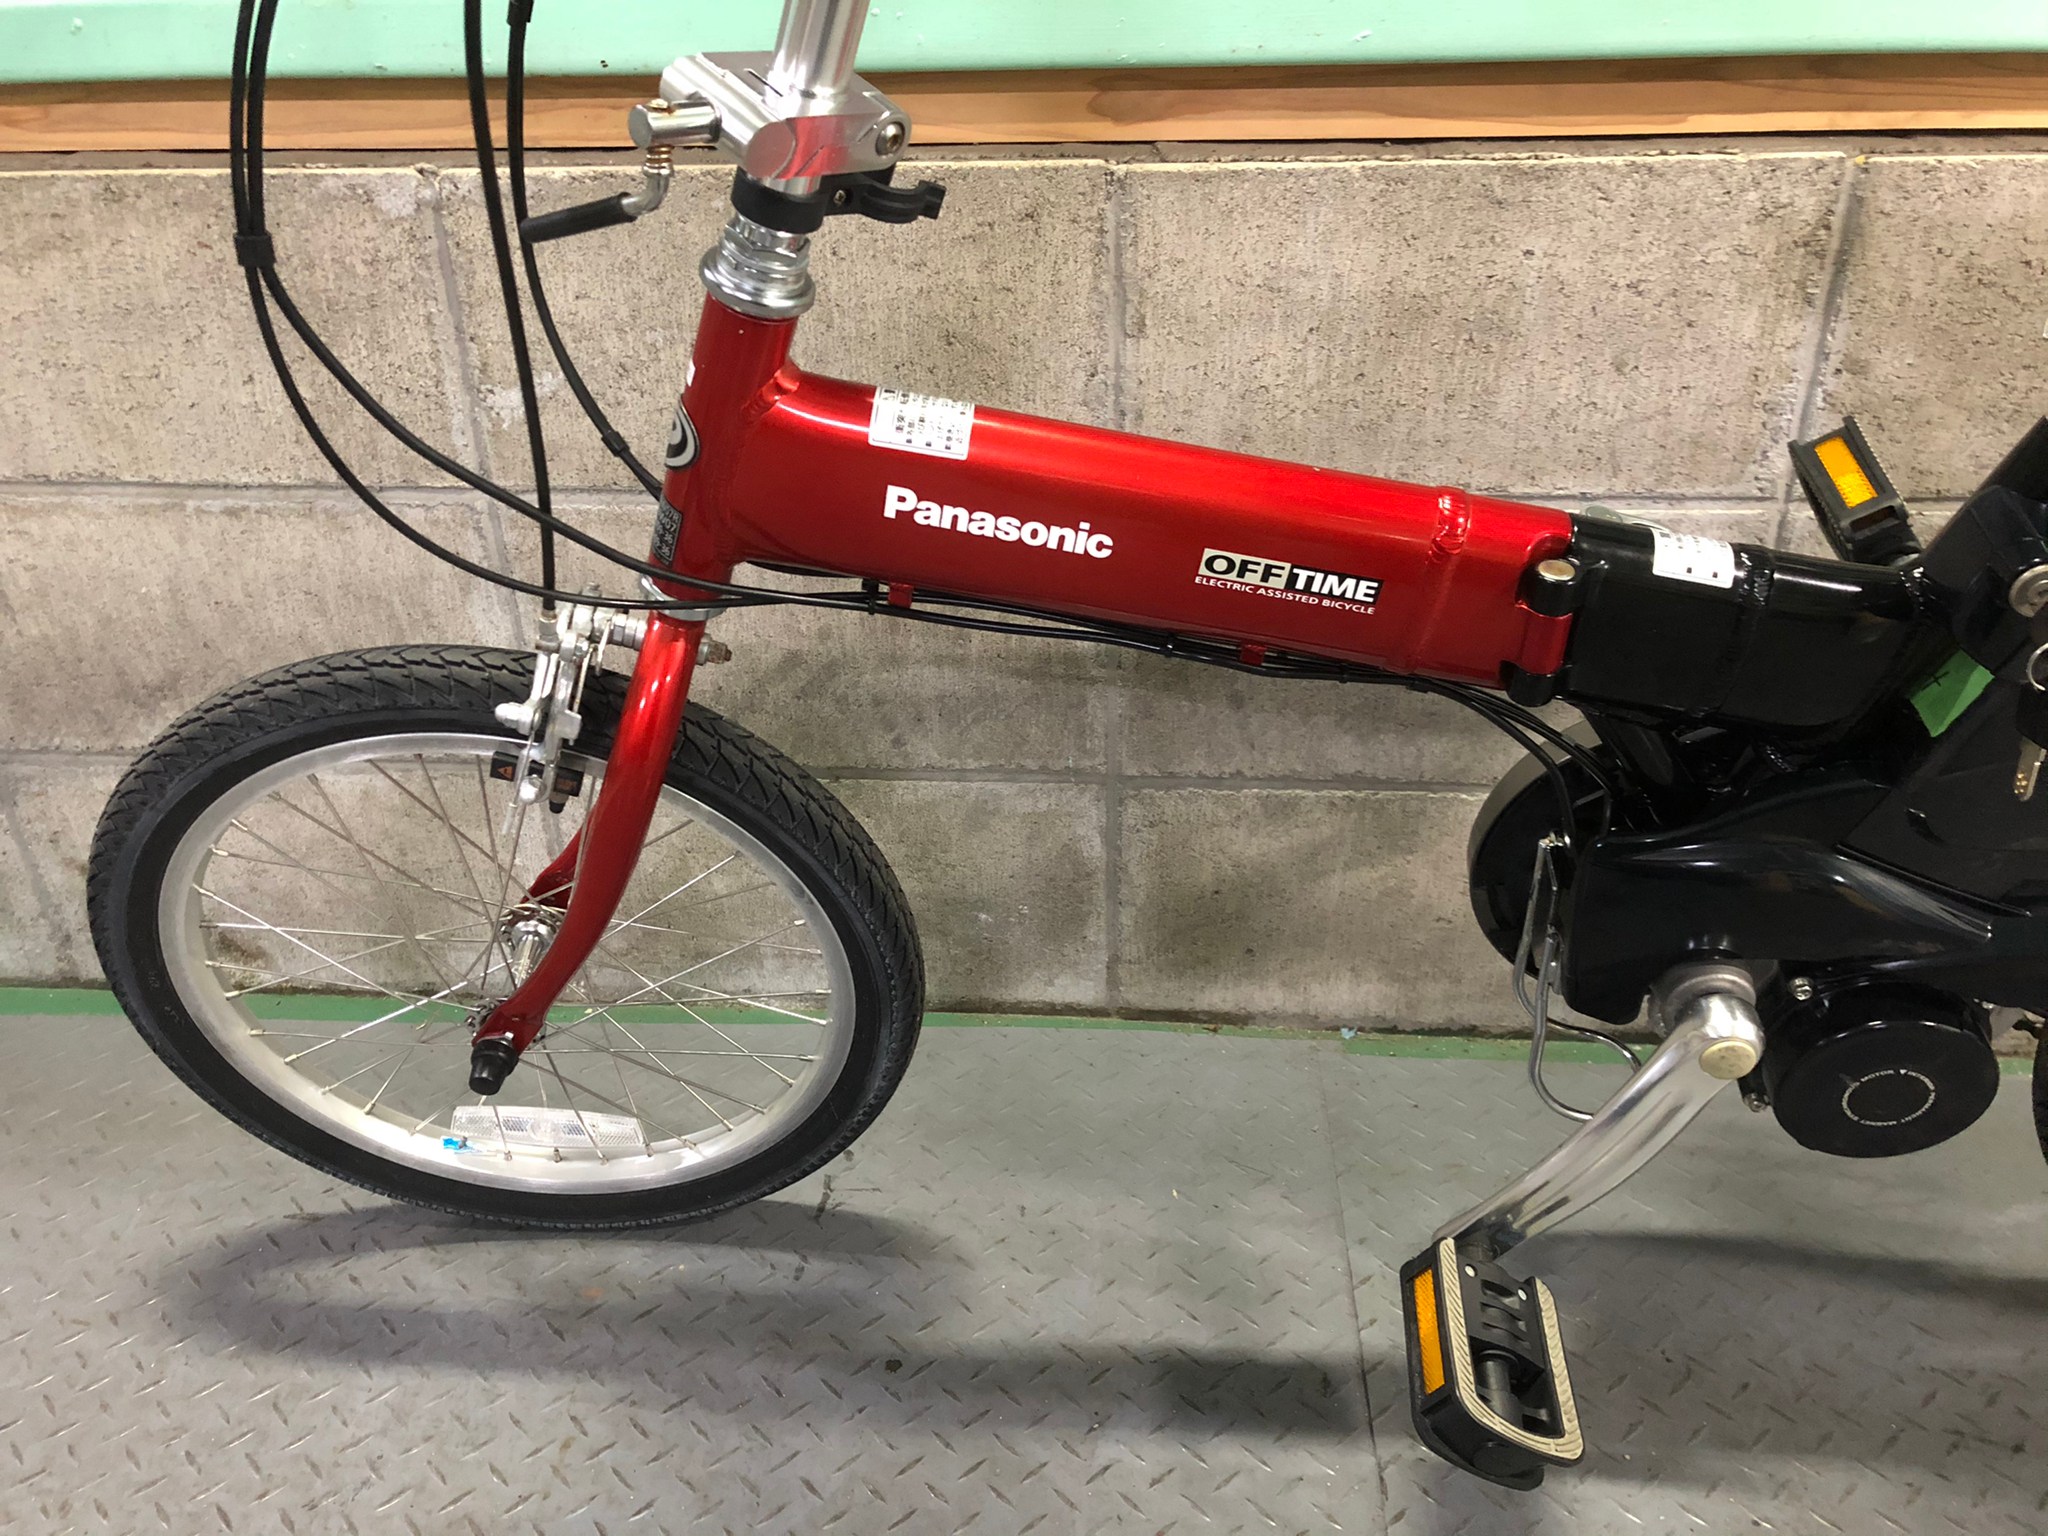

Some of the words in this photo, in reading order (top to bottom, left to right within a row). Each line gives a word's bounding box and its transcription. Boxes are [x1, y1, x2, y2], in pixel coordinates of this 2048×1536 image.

[883, 484, 1115, 559] Panasonic
[1194, 575, 1254, 594] ELECTRIC
[1256, 588, 1319, 605] ASSISTED
[1322, 599, 1376, 615] BICYCLE
